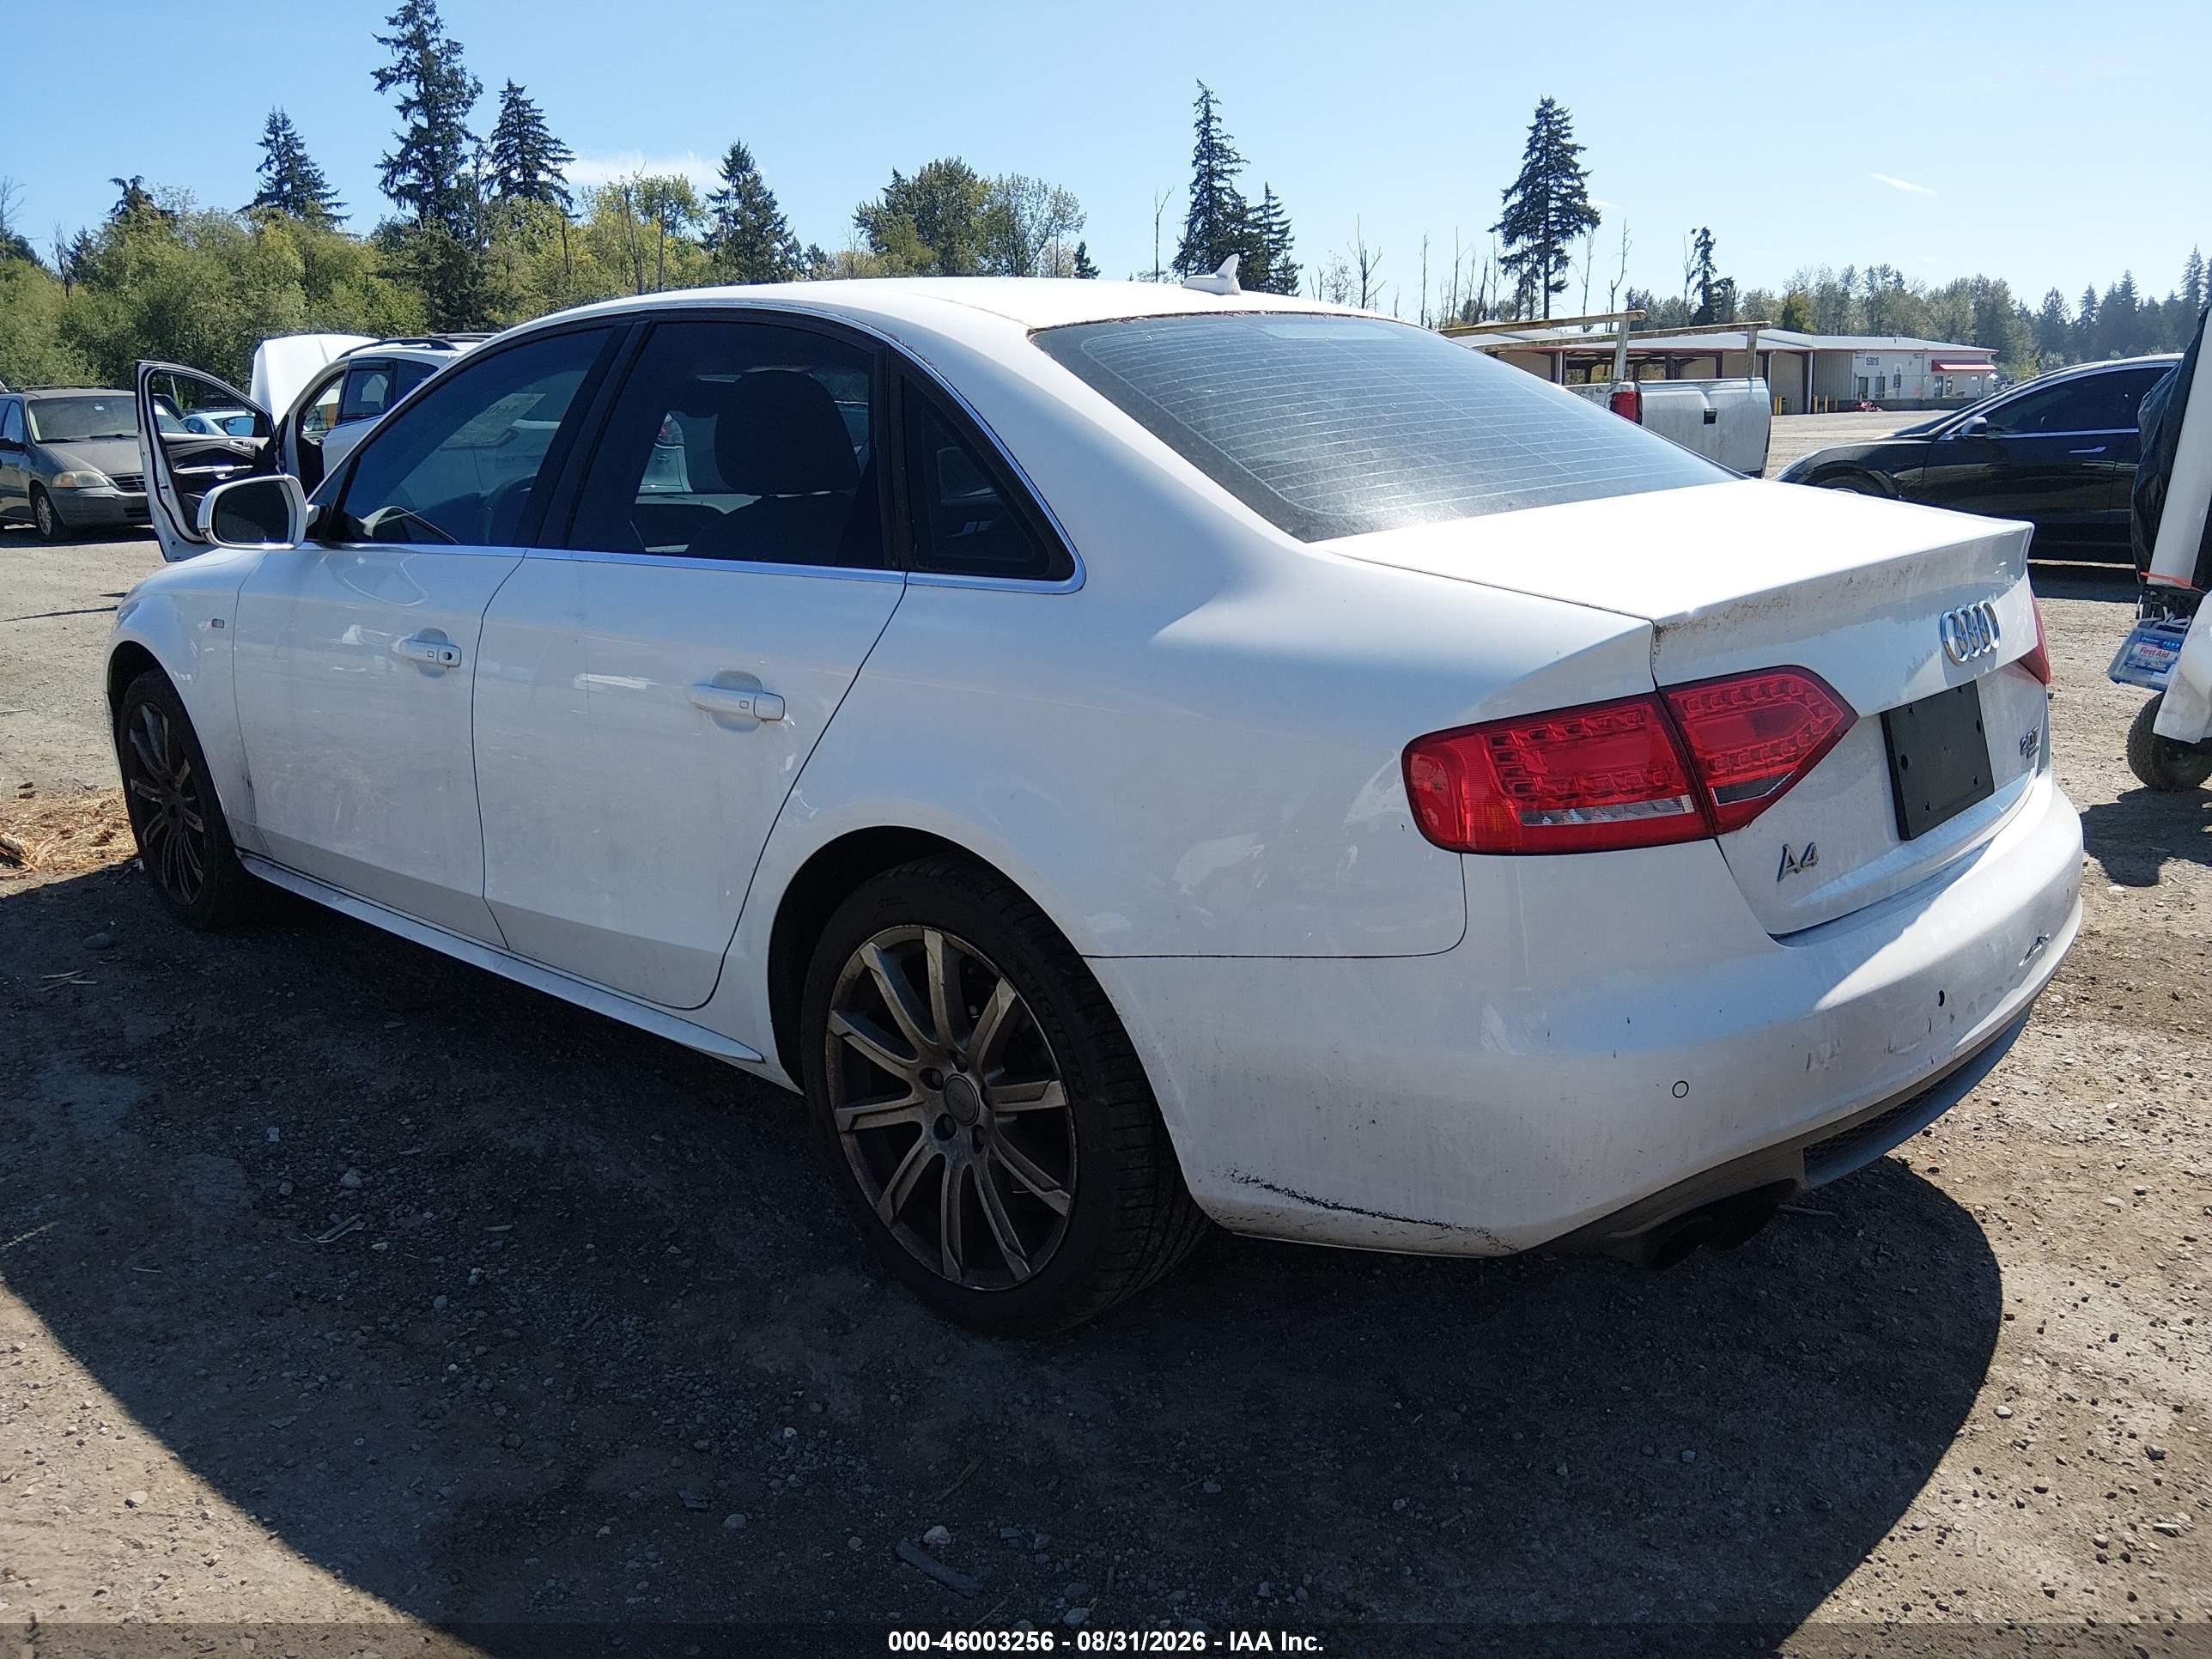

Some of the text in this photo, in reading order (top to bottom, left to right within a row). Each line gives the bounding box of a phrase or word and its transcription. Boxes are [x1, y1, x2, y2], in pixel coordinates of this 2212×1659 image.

[2140, 647, 2170, 659] First Aid
[1777, 842, 1820, 882] A4
